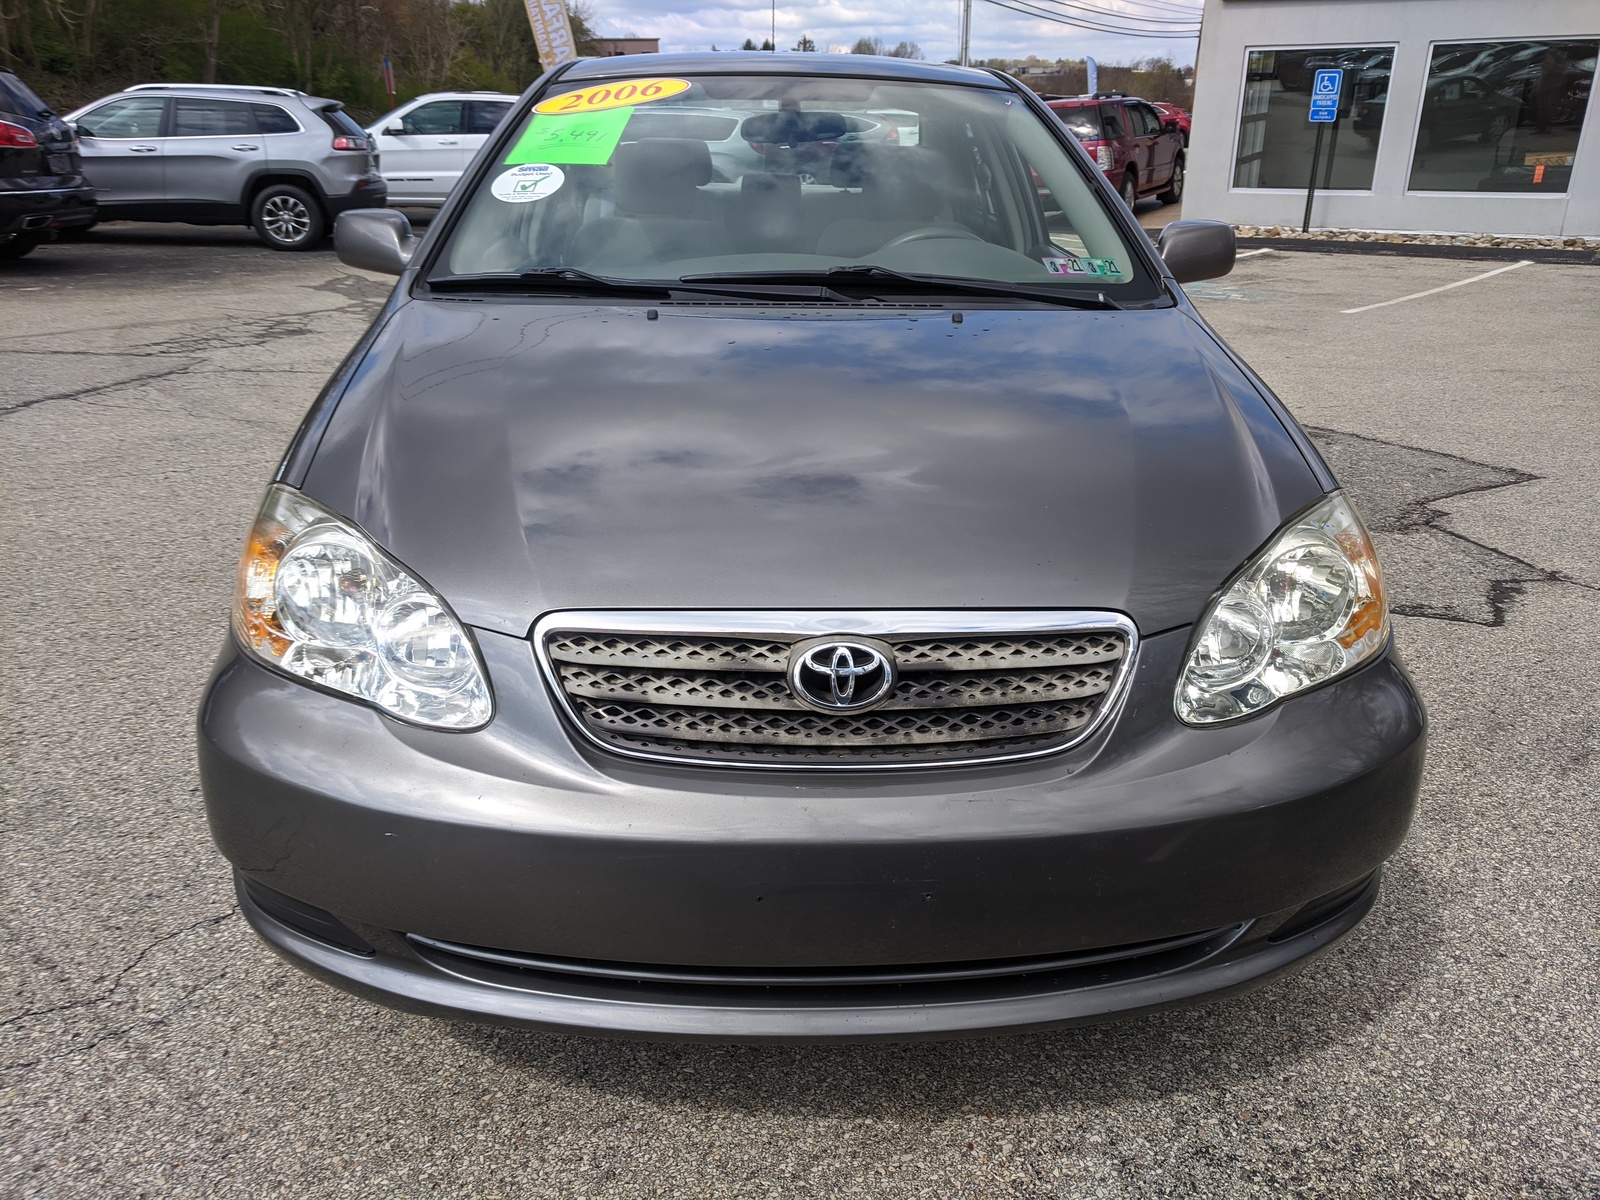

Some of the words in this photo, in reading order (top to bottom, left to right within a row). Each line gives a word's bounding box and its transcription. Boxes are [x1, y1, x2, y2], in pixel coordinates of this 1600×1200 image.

[558, 80, 665, 111] 2006
[536, 127, 608, 143] $5,491
[1067, 258, 1084, 272] 21
[1104, 260, 1121, 273] 21
